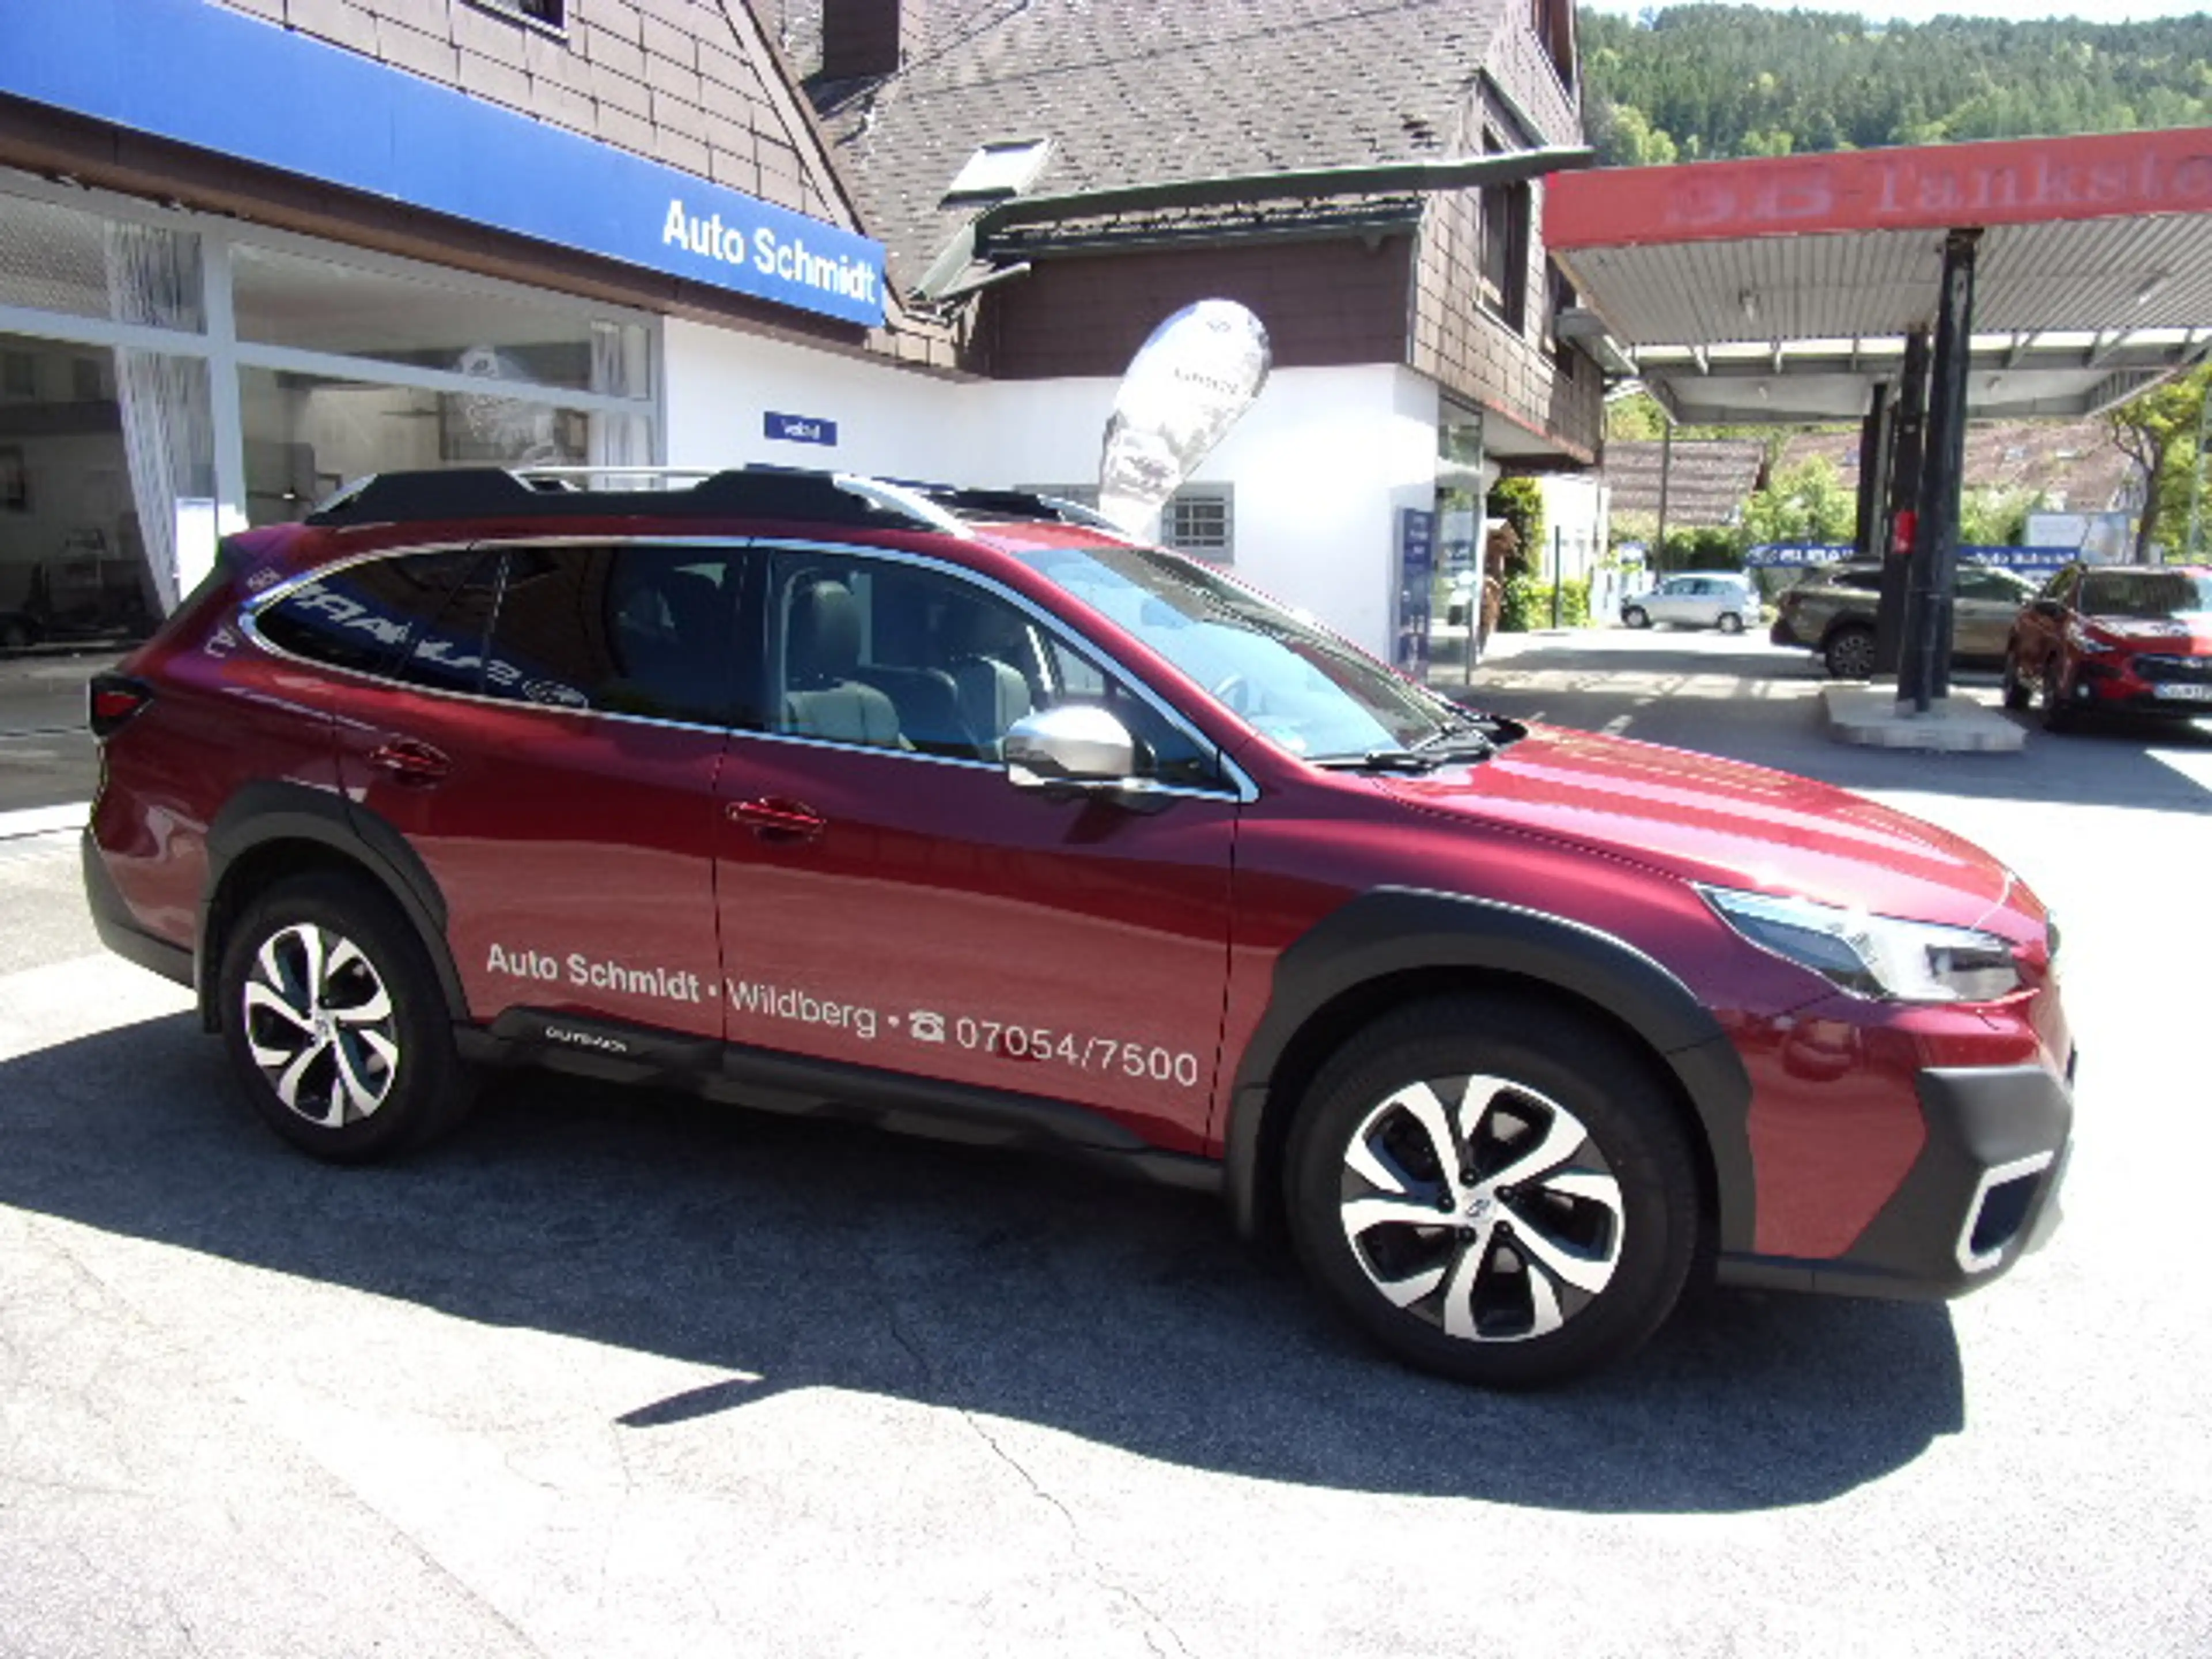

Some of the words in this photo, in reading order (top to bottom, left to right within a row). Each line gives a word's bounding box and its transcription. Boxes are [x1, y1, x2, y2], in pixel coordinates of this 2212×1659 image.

[663, 199, 745, 264] Auto
[752, 228, 876, 304] Schmidt
[487, 943, 558, 979] Auto
[567, 953, 700, 1002] Schmidt
[726, 978, 876, 1038] Wildberg
[956, 1017, 1198, 1086] 07054/7500
